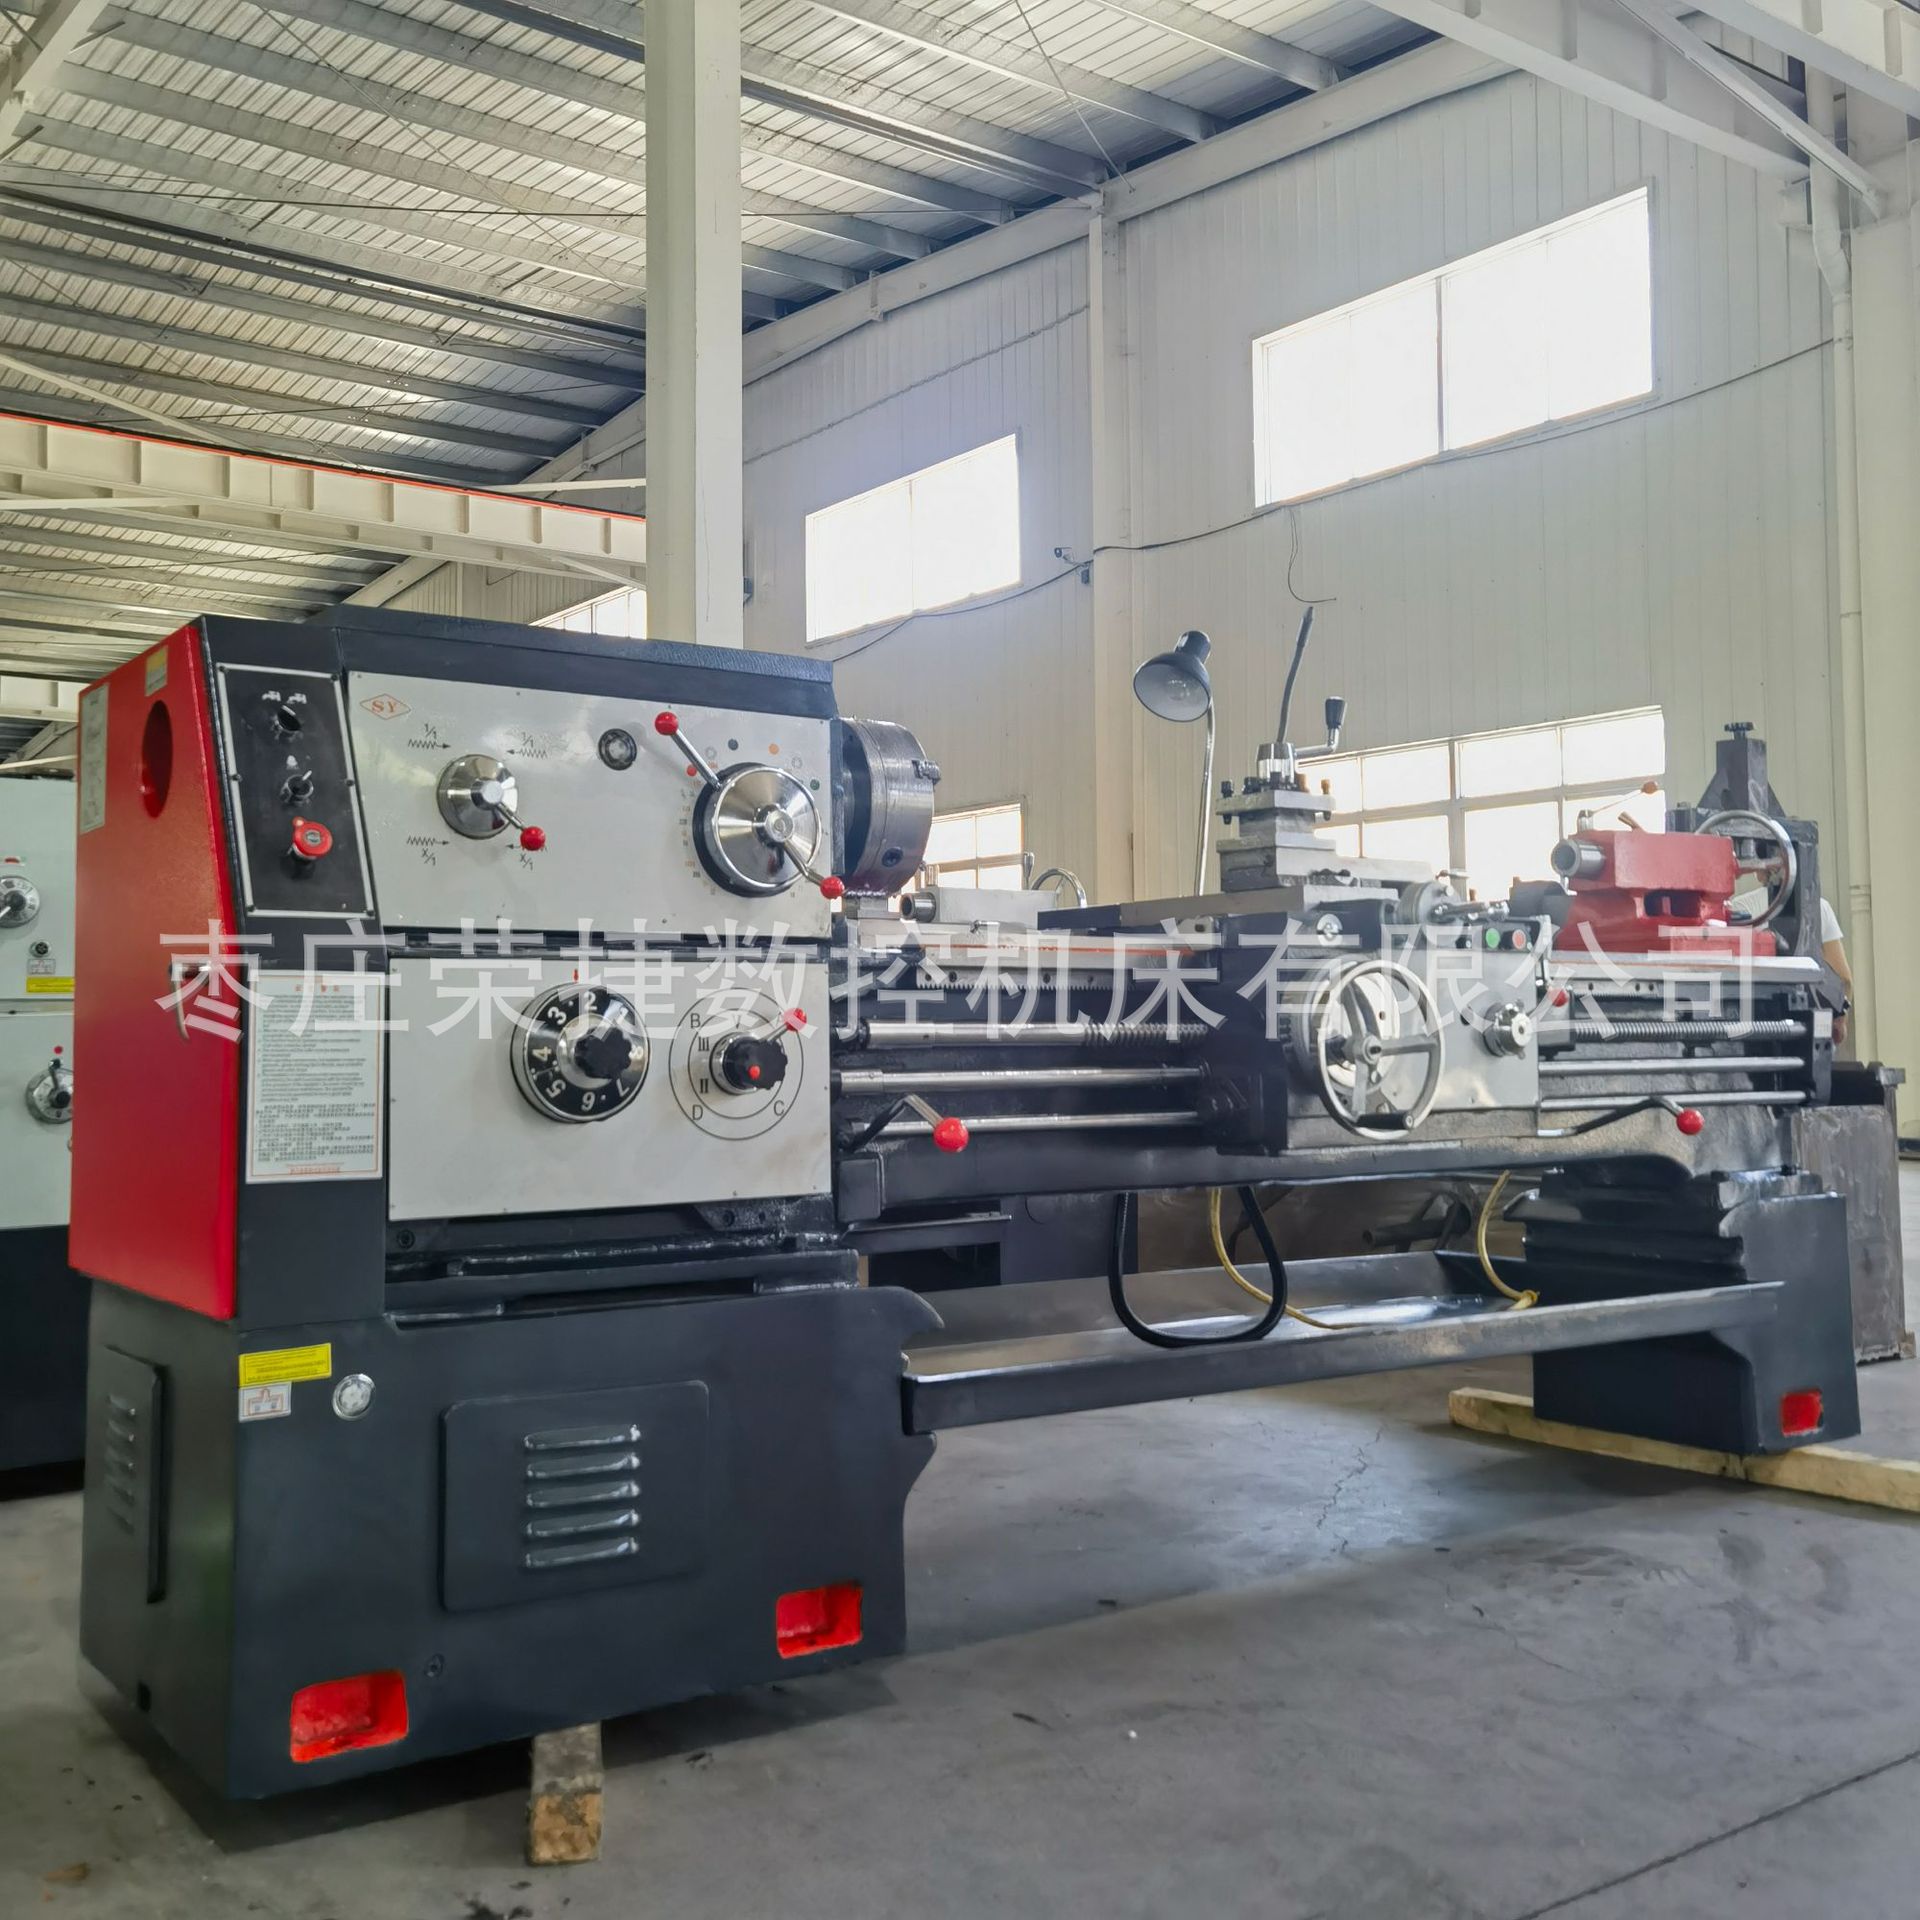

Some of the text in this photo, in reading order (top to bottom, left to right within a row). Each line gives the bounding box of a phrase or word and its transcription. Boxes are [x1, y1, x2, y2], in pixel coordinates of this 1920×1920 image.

[371, 700, 397, 714] SY
[583, 991, 598, 1011] 2
[547, 1006, 567, 1026] 3
[690, 1013, 701, 1029] B
[698, 1036, 710, 1052] III
[532, 1046, 552, 1061] 4
[545, 1079, 567, 1098] 5
[616, 1078, 630, 1097] 7
[700, 1078, 709, 1094] II
[581, 1092, 596, 1111] 6
[773, 1100, 785, 1116] C
[692, 1104, 704, 1120] D
